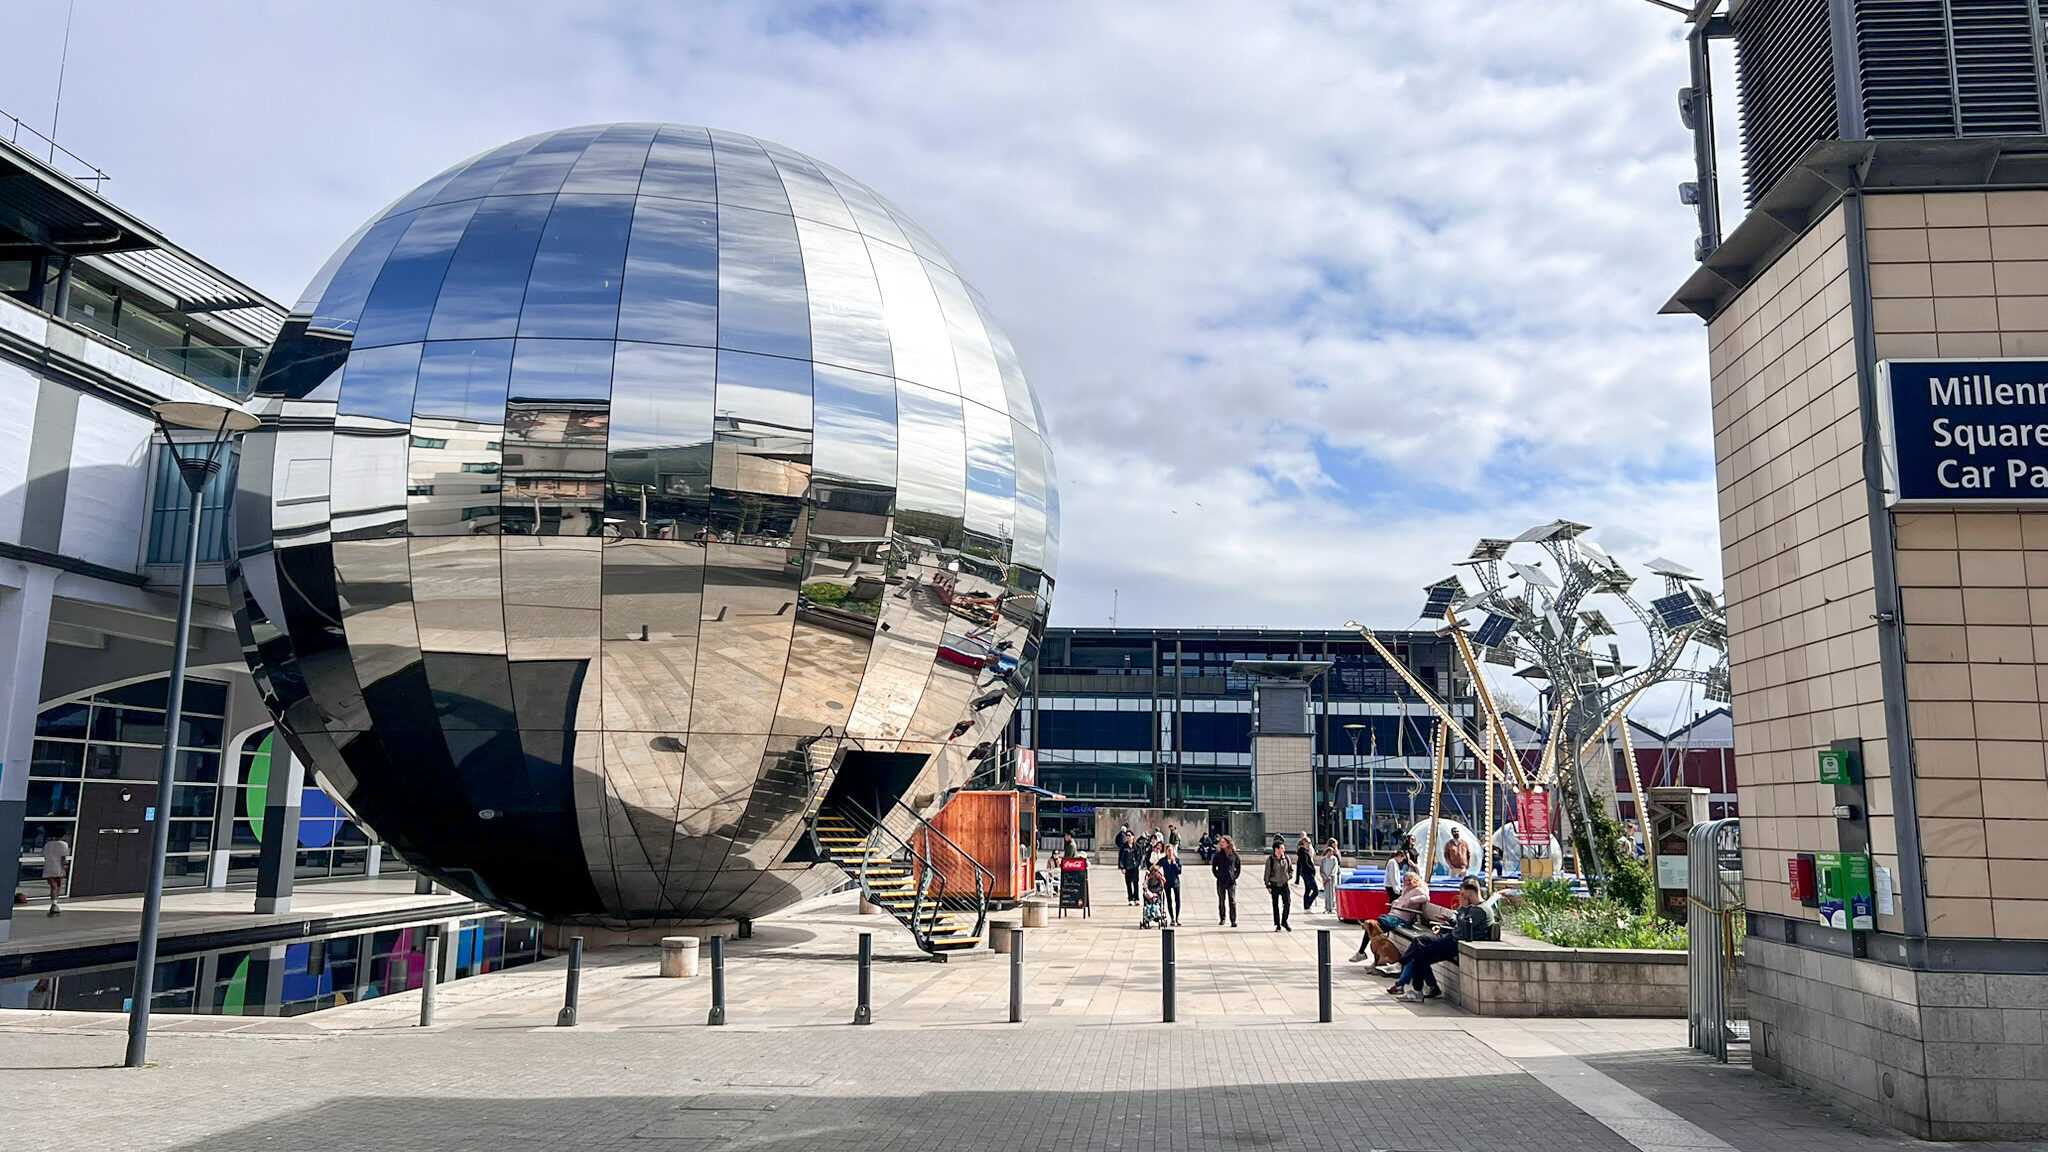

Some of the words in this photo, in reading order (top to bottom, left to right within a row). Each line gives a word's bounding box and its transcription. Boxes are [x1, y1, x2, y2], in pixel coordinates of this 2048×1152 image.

[1933, 418, 2048, 455] Square
[1937, 459, 1995, 489] Car
[2007, 459, 2048, 489] Pa
